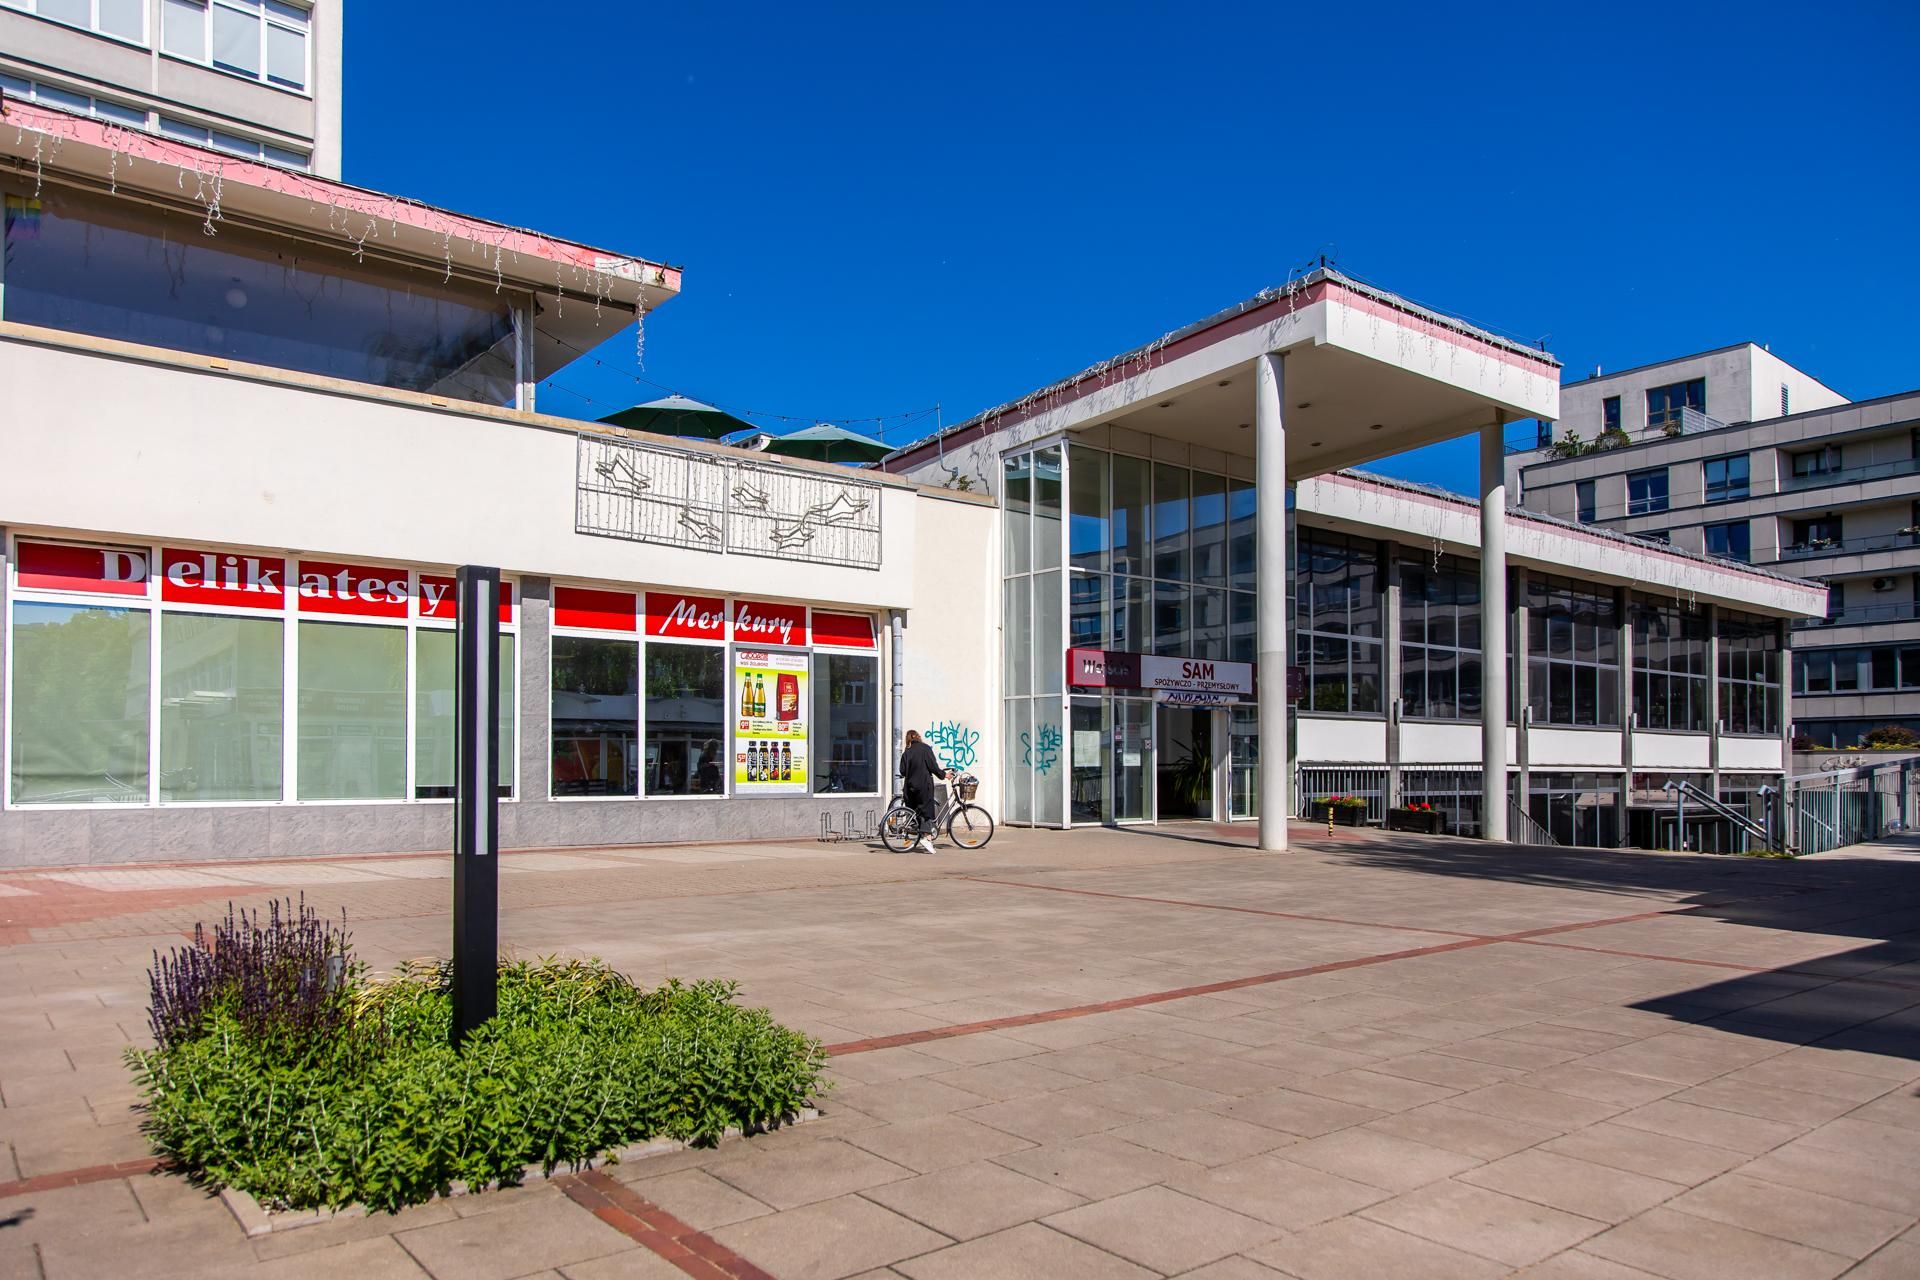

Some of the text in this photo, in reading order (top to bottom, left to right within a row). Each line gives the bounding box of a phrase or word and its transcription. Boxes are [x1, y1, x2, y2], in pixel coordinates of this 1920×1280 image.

[659, 599, 793, 644] Merkury
[1182, 661, 1215, 680] SAM
[1154, 678, 1192, 688] SPOŻYWCZO
[1197, 680, 1240, 691] PRZEMYSŁOWY
